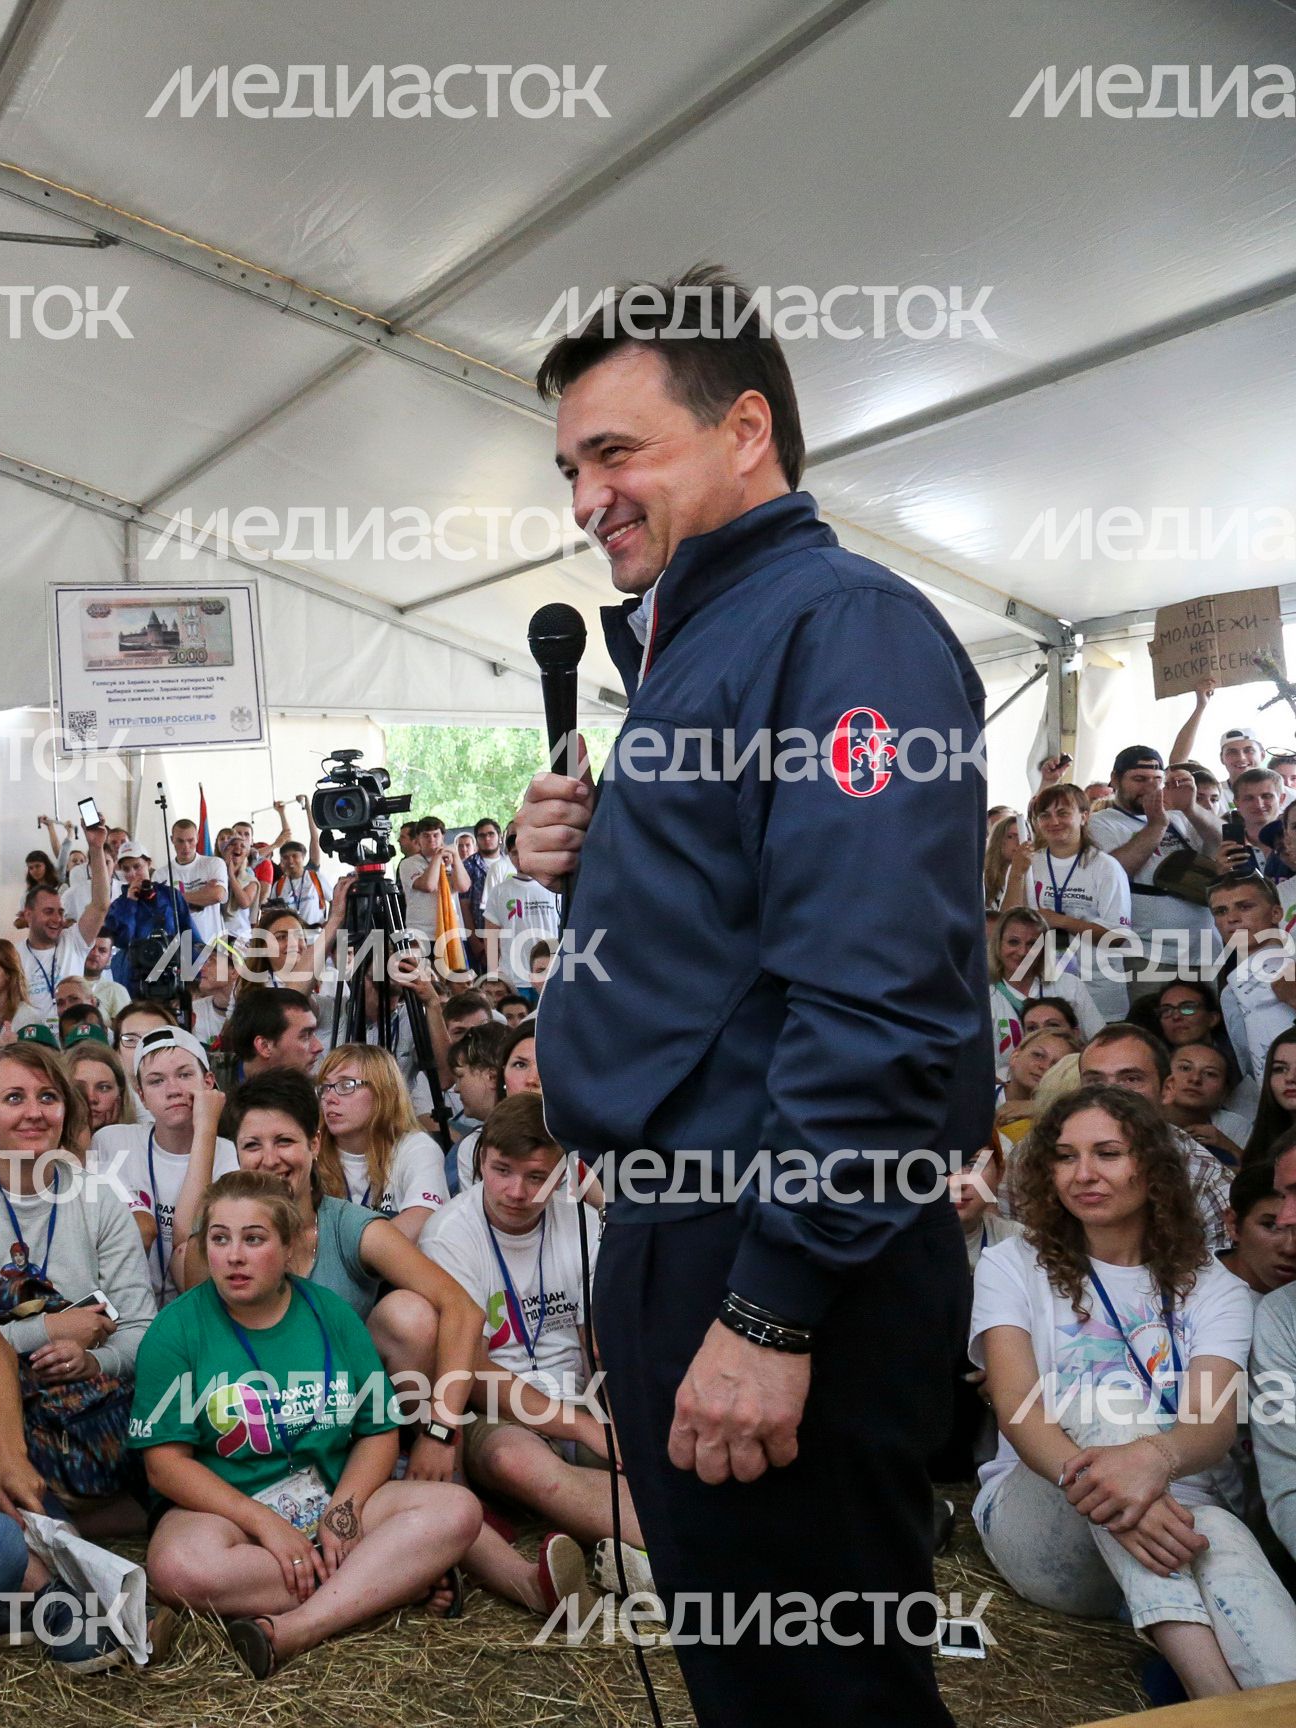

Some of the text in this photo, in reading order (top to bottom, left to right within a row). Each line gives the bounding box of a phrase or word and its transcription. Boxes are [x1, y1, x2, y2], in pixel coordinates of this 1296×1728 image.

[1185, 599, 1216, 620] НЕТ
[1190, 638, 1214, 655] НЕТ
[168, 647, 208, 664] 2000
